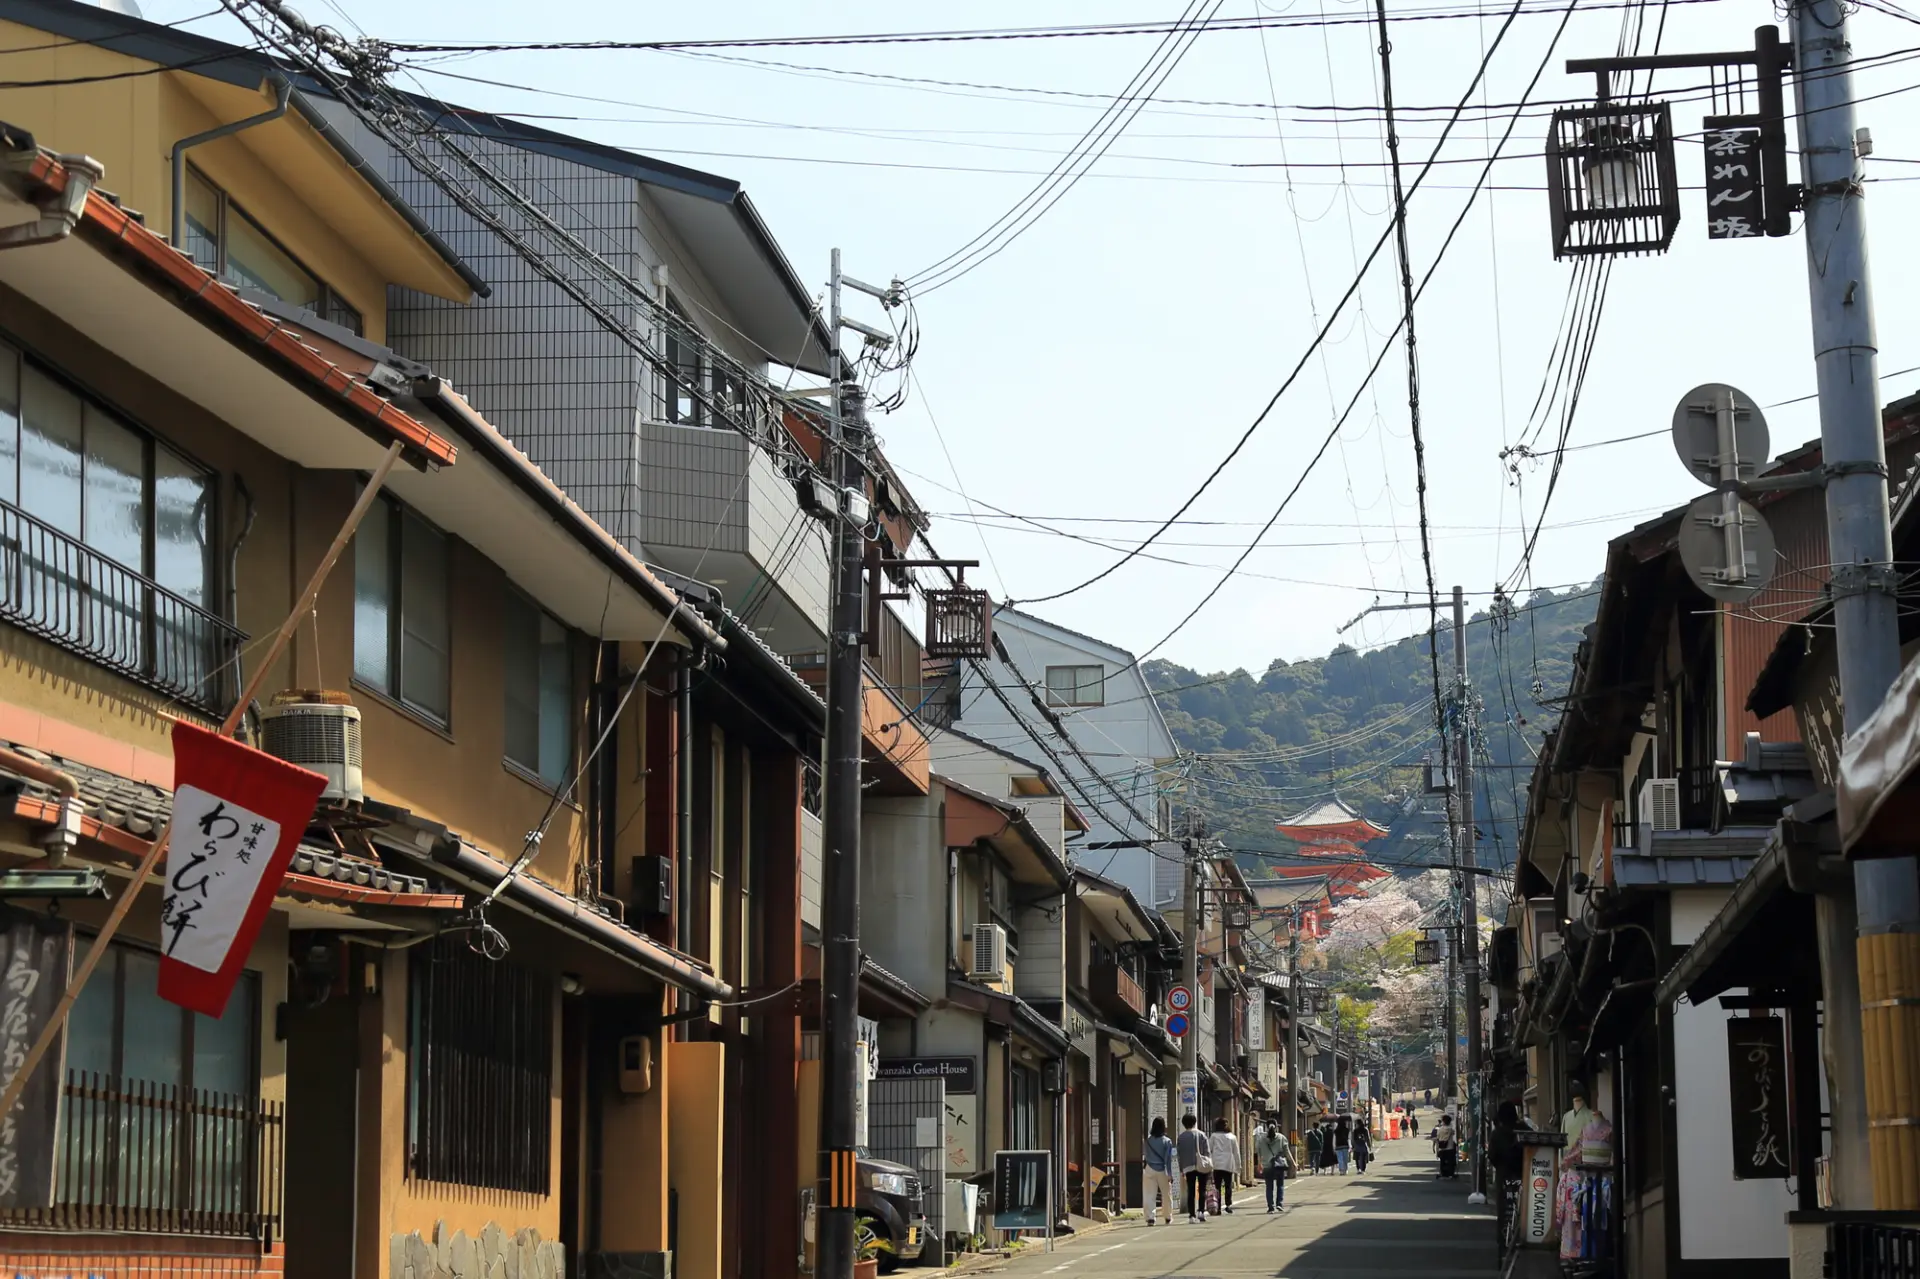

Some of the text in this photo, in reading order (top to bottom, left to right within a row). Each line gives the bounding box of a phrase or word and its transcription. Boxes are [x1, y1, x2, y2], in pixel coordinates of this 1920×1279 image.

[1707, 131, 1756, 238] 茶わん坂
[234, 821, 267, 865] 甘味処
[161, 801, 240, 957] わらび餅
[1173, 993, 1187, 1005] 30
[878, 1062, 968, 1075] wanzaka Guest House
[1531, 1167, 1553, 1178] Kimono
[1532, 1158, 1551, 1168] Rental
[1532, 1192, 1546, 1237] OKAMOTO
